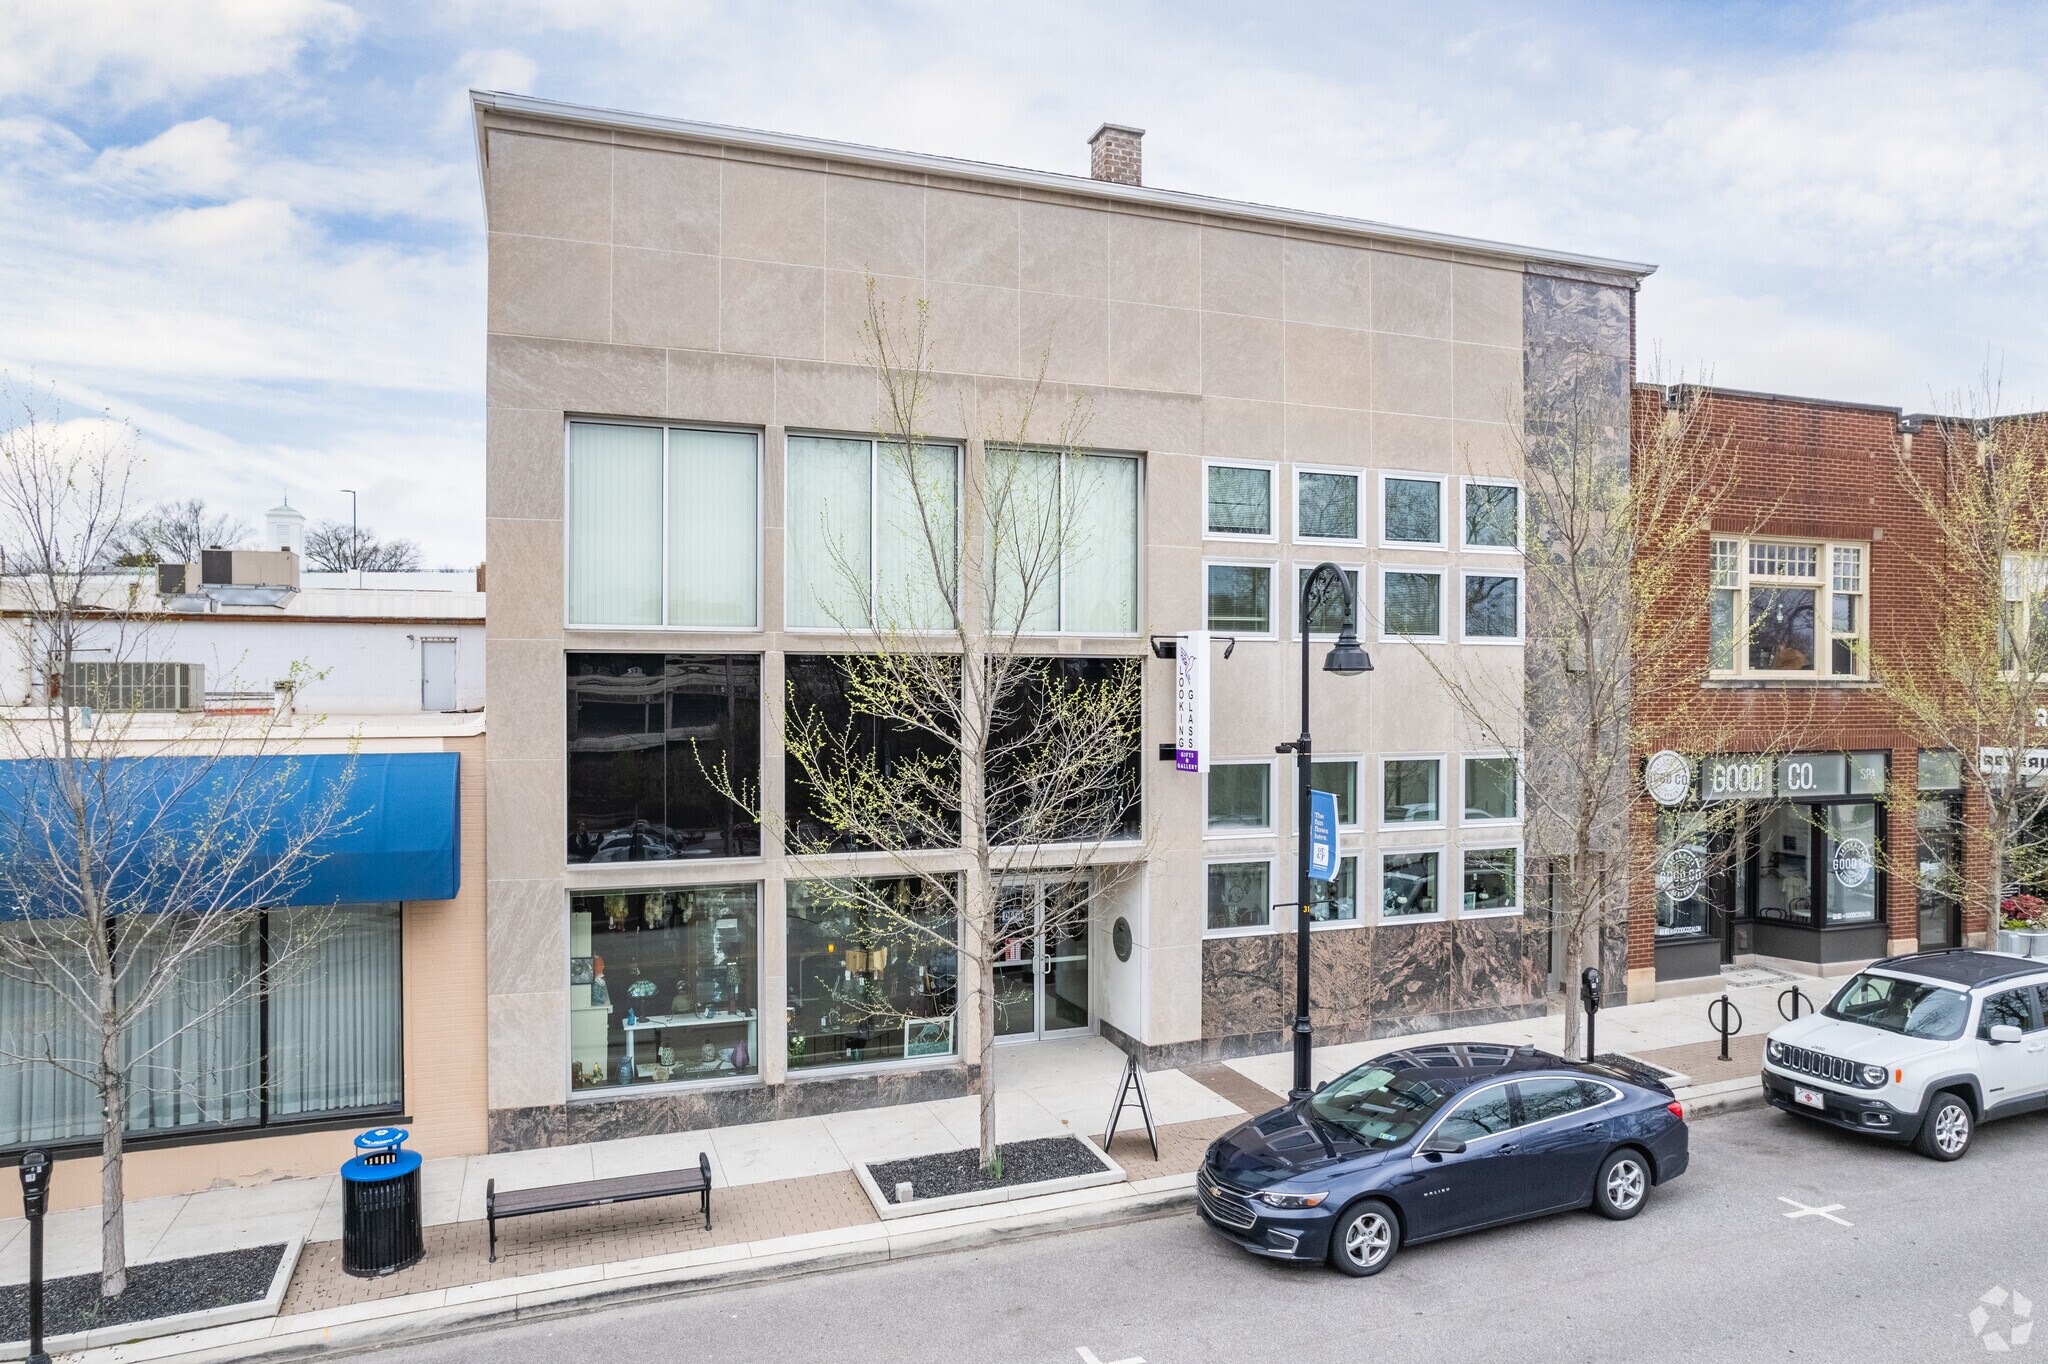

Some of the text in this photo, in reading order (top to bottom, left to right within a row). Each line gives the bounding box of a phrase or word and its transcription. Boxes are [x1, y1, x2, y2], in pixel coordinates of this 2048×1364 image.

[1675, 774, 1688, 786] CO
[1713, 764, 1763, 793] GOOD
[1788, 762, 1817, 790] CO.
[1860, 768, 1876, 780] SPA
[1314, 811, 1325, 819] The
[1314, 825, 1329, 834] flows
[1833, 858, 1857, 870] GOOD
[1660, 870, 1686, 883] GOOD
[1423, 1187, 1450, 1197] MALIBU
